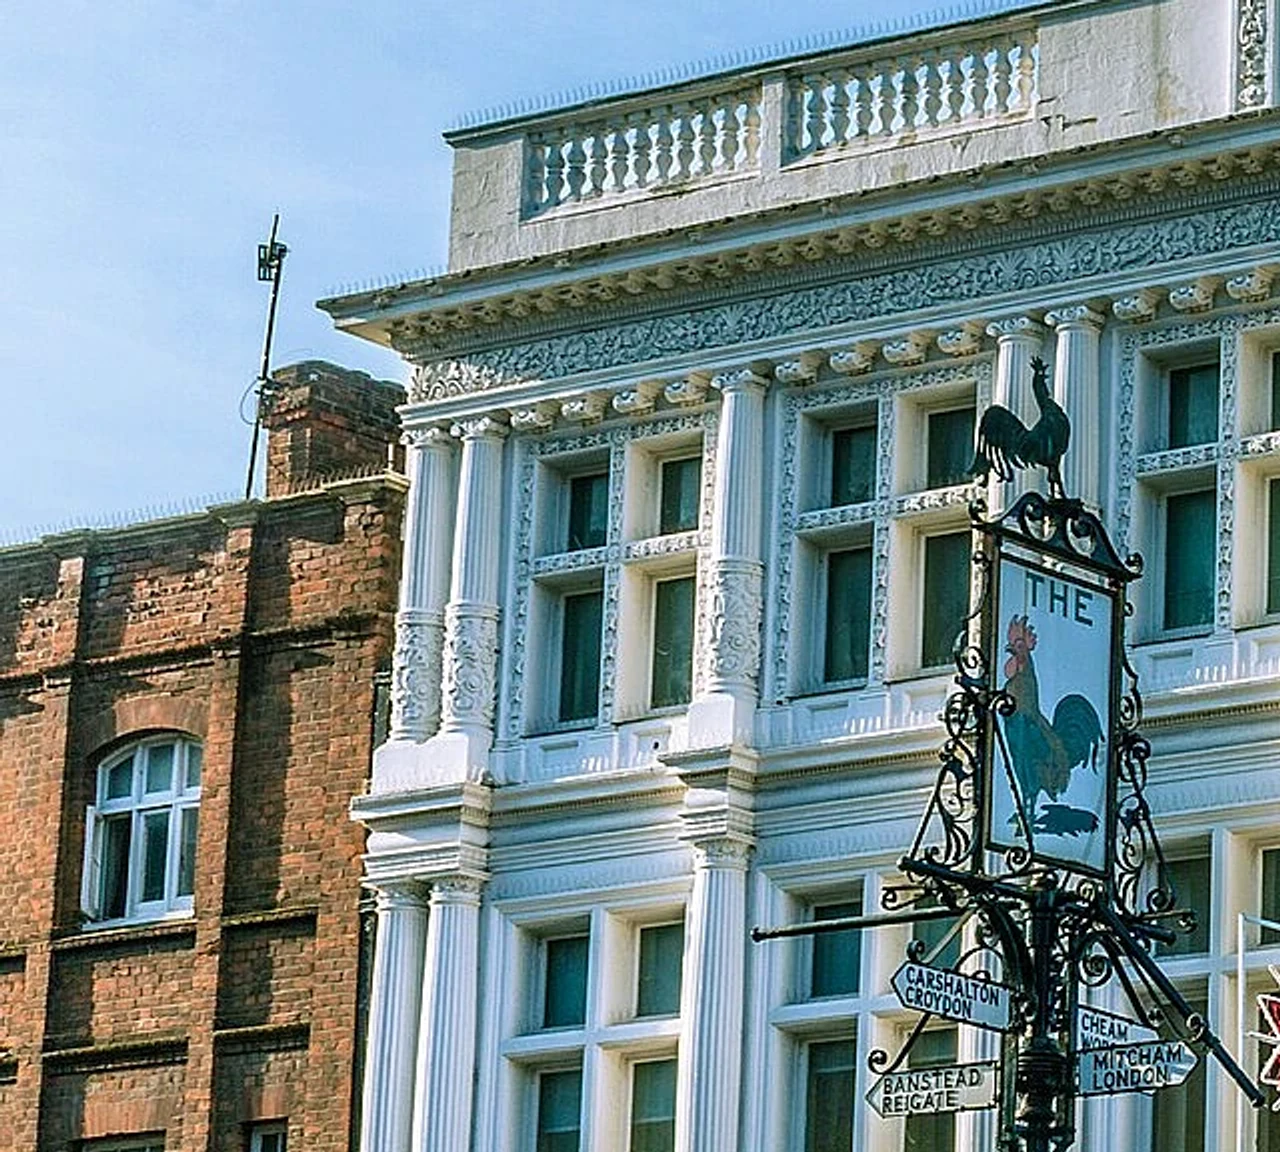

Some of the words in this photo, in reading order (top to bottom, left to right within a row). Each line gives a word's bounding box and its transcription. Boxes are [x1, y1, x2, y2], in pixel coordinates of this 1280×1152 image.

[1025, 570, 1093, 627] THE
[906, 966, 1000, 1007] CARSHALTON
[905, 986, 972, 1019] CROYDON
[1082, 1012, 1128, 1042] CHEAM
[1093, 1043, 1182, 1070] MITCHAM
[883, 1068, 984, 1095] BANSTEAD
[1093, 1065, 1168, 1090] LONDON
[882, 1090, 960, 1114] REIGATE
